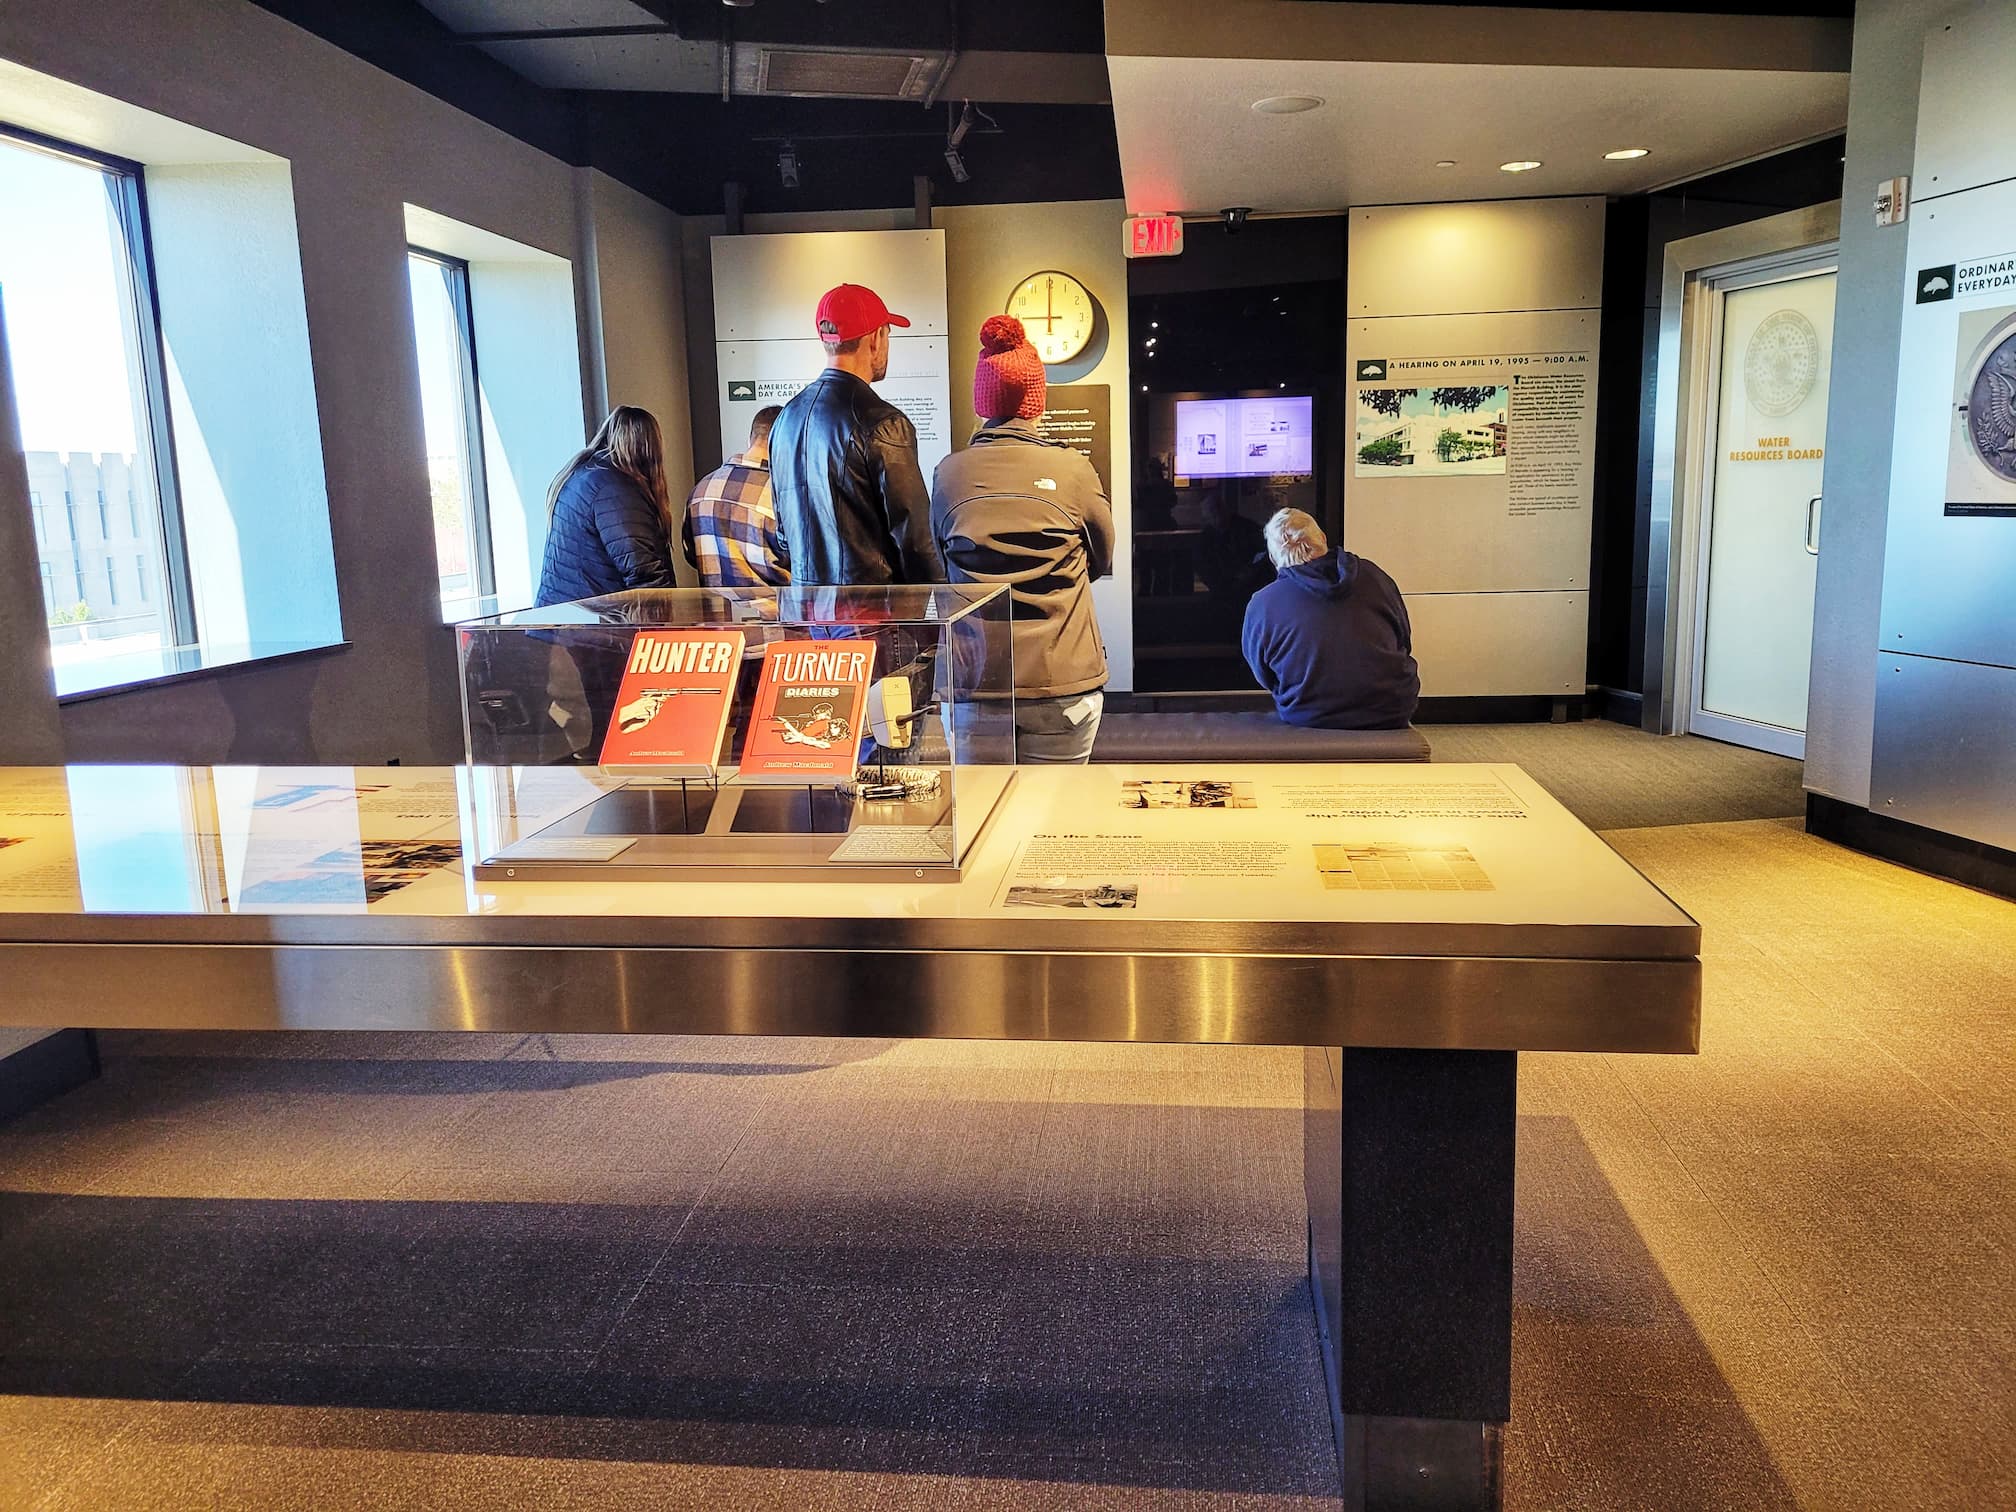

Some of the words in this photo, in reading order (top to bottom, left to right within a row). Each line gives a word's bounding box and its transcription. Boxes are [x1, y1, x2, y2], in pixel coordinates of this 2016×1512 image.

[1133, 217, 1176, 254] EXIT
[1959, 260, 2016, 279] ORDINAR
[1958, 274, 2016, 293] EVERYDAY
[1389, 361, 1395, 369] A
[1399, 360, 1439, 369] HEARING
[1460, 359, 1486, 367] APRIL
[1489, 358, 1503, 366] 19,
[1507, 357, 1529, 365] 1995
[1544, 356, 1565, 364] 9:00
[1568, 355, 1589, 363] A.M.
[758, 383, 801, 391] AMERICA'S
[758, 390, 774, 398] DAY
[1758, 436, 1791, 448] WATER
[1729, 450, 1784, 461] RESOURCES
[1787, 448, 1824, 460] BOARD
[629, 637, 734, 674] HUNTER
[771, 652, 867, 683] TURNER
[785, 687, 841, 698] DIARIES
